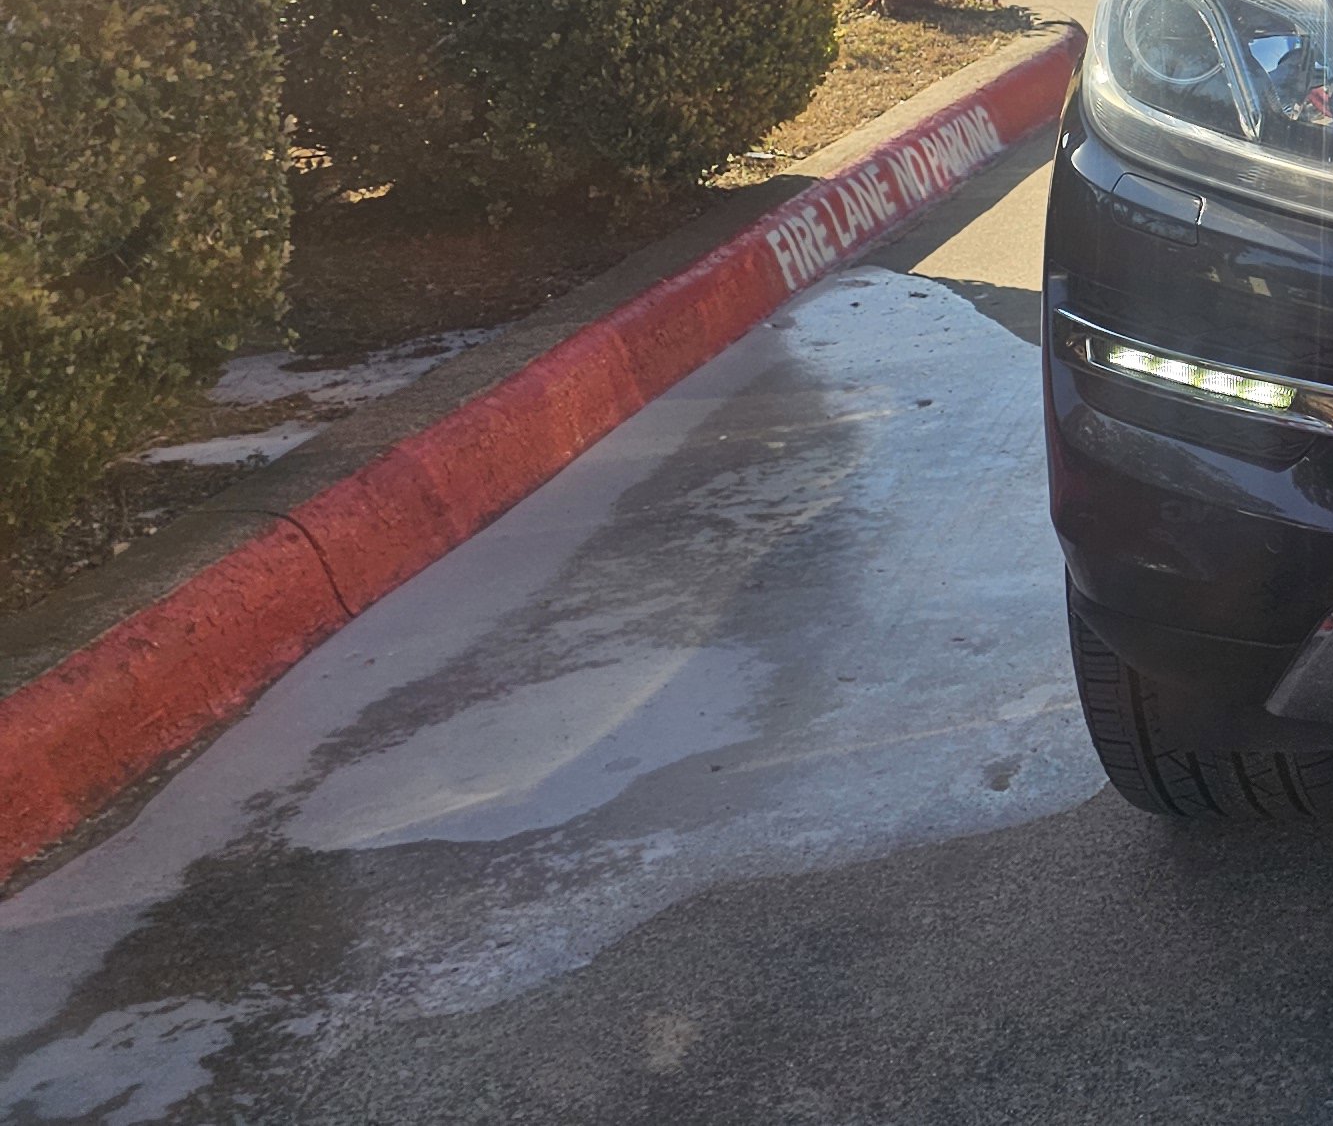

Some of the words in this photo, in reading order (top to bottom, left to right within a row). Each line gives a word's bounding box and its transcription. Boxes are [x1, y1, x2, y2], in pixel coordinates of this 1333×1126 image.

[765, 205, 837, 292] FIRE
[819, 164, 897, 249] LANE
[888, 147, 929, 200] NO
[918, 105, 1002, 189] PARKING
